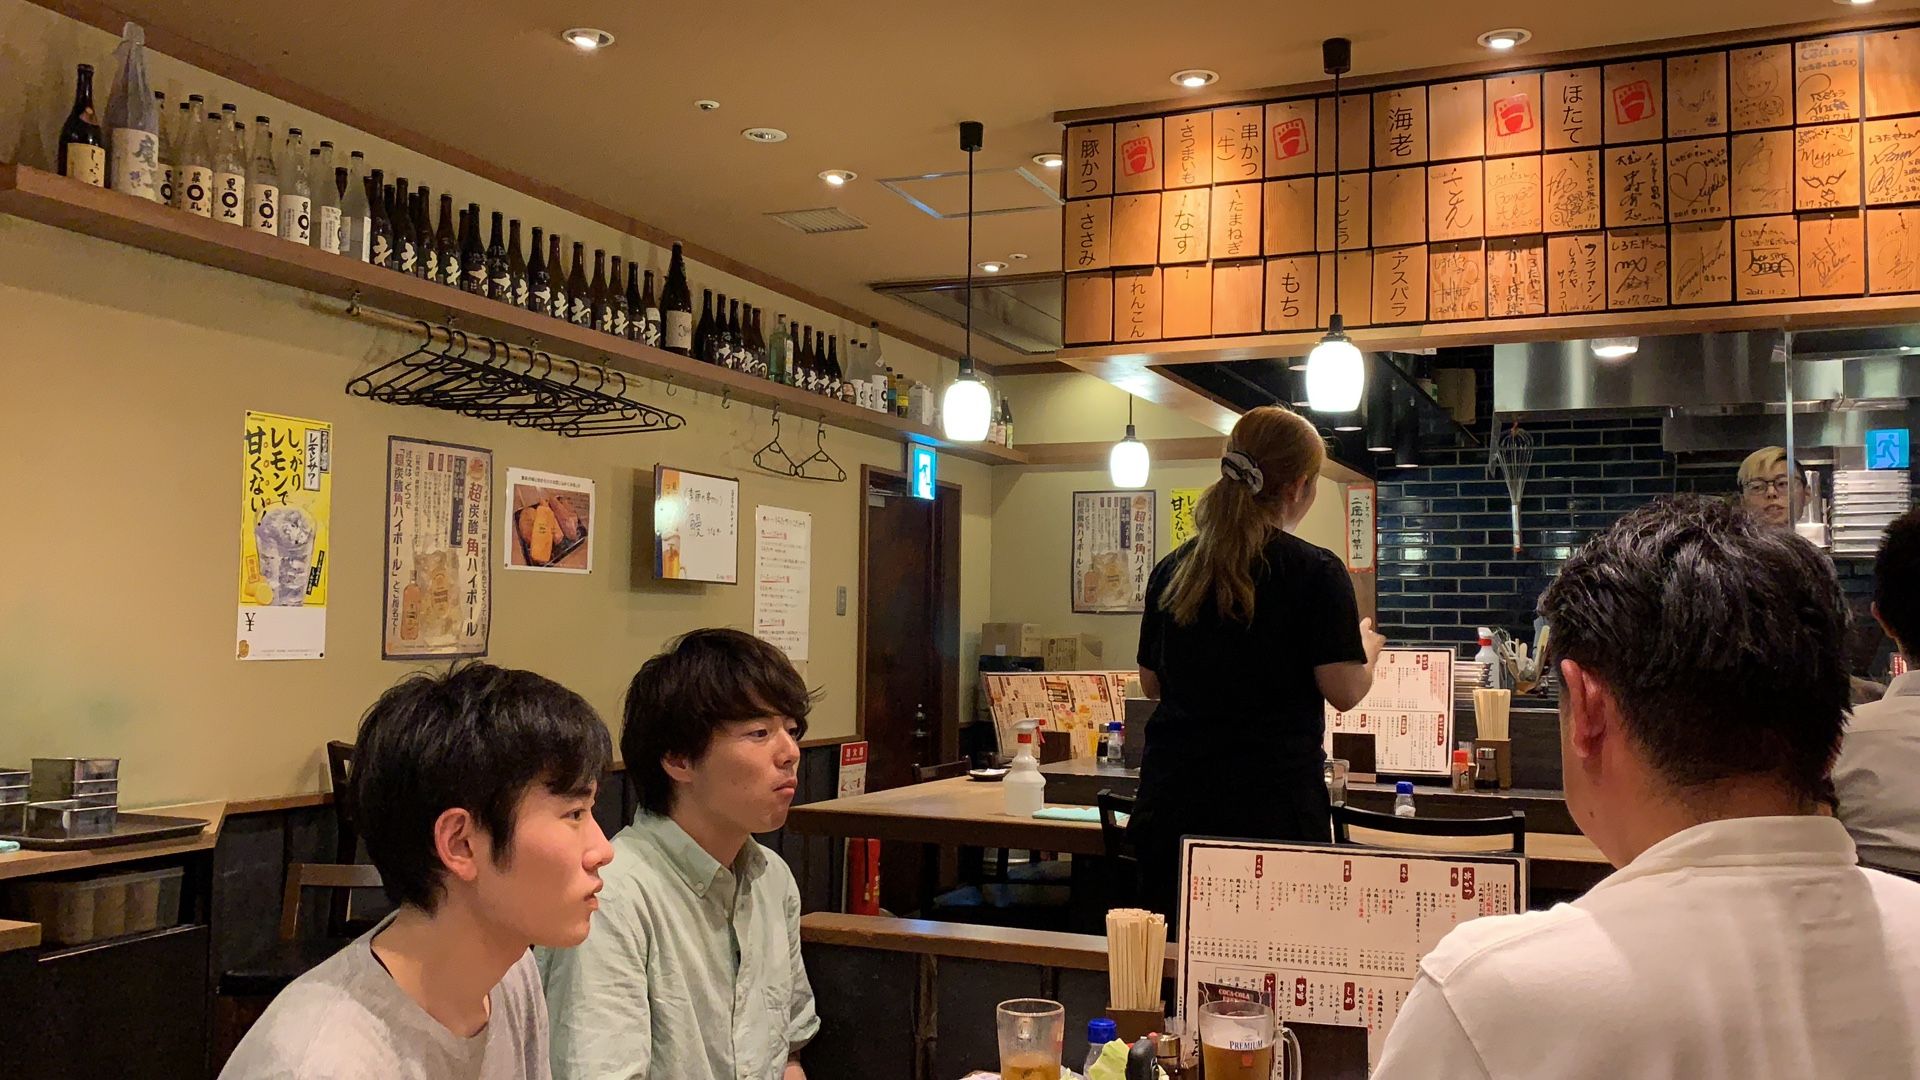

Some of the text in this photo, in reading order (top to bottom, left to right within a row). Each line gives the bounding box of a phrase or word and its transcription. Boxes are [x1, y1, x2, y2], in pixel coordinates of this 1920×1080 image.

[1388, 106, 1414, 157] 海老
[1562, 85, 1584, 144] ほたて
[1080, 139, 1100, 193] 豚かつ
[1181, 124, 1195, 184] さつまいも
[1240, 123, 1258, 176] 串かつ
[1079, 212, 1096, 266] ささみ
[1175, 209, 1195, 254] なす
[1227, 199, 1243, 255] たまねぎ
[1131, 282, 1144, 337] れんこん
[1281, 272, 1300, 317] もち
[1392, 254, 1408, 317] アスパラ
[245, 426, 268, 526] 甘くない!
[271, 427, 289, 506] レモンで
[288, 428, 303, 491] しっかり
[466, 482, 483, 637] 超炭酸角ハイボール
[1463, 871, 1473, 896] 串かつ
[1229, 1040, 1264, 1051] PREMIUM
